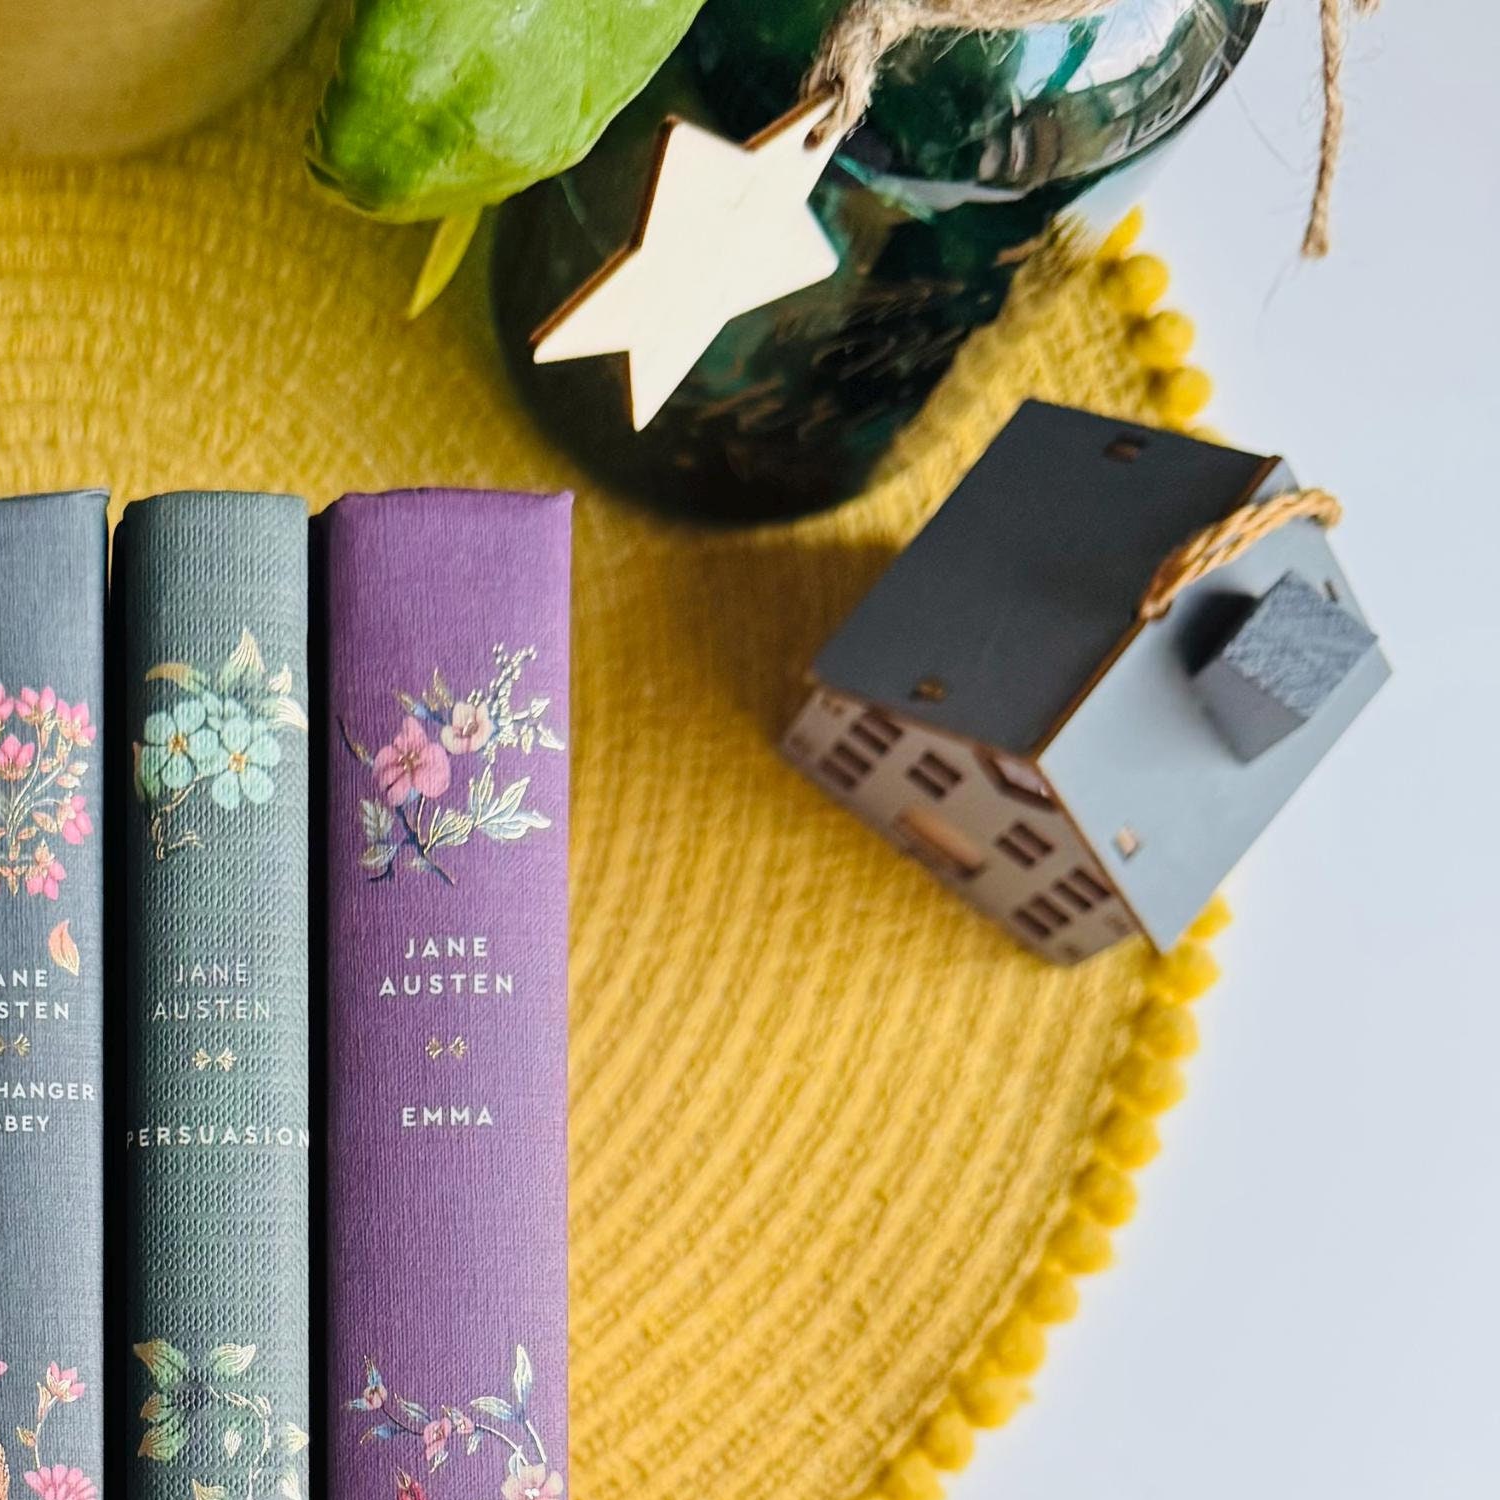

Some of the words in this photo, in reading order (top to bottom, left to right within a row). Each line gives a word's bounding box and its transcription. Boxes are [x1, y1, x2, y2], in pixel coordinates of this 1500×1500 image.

[404, 937, 488, 959] JANE
[175, 963, 249, 984] JANE
[378, 973, 514, 997] AUSTEN
[152, 1001, 271, 1021] AUSTEN
[402, 1106, 493, 1127] EMMA
[126, 1125, 309, 1149] PERSUASION
